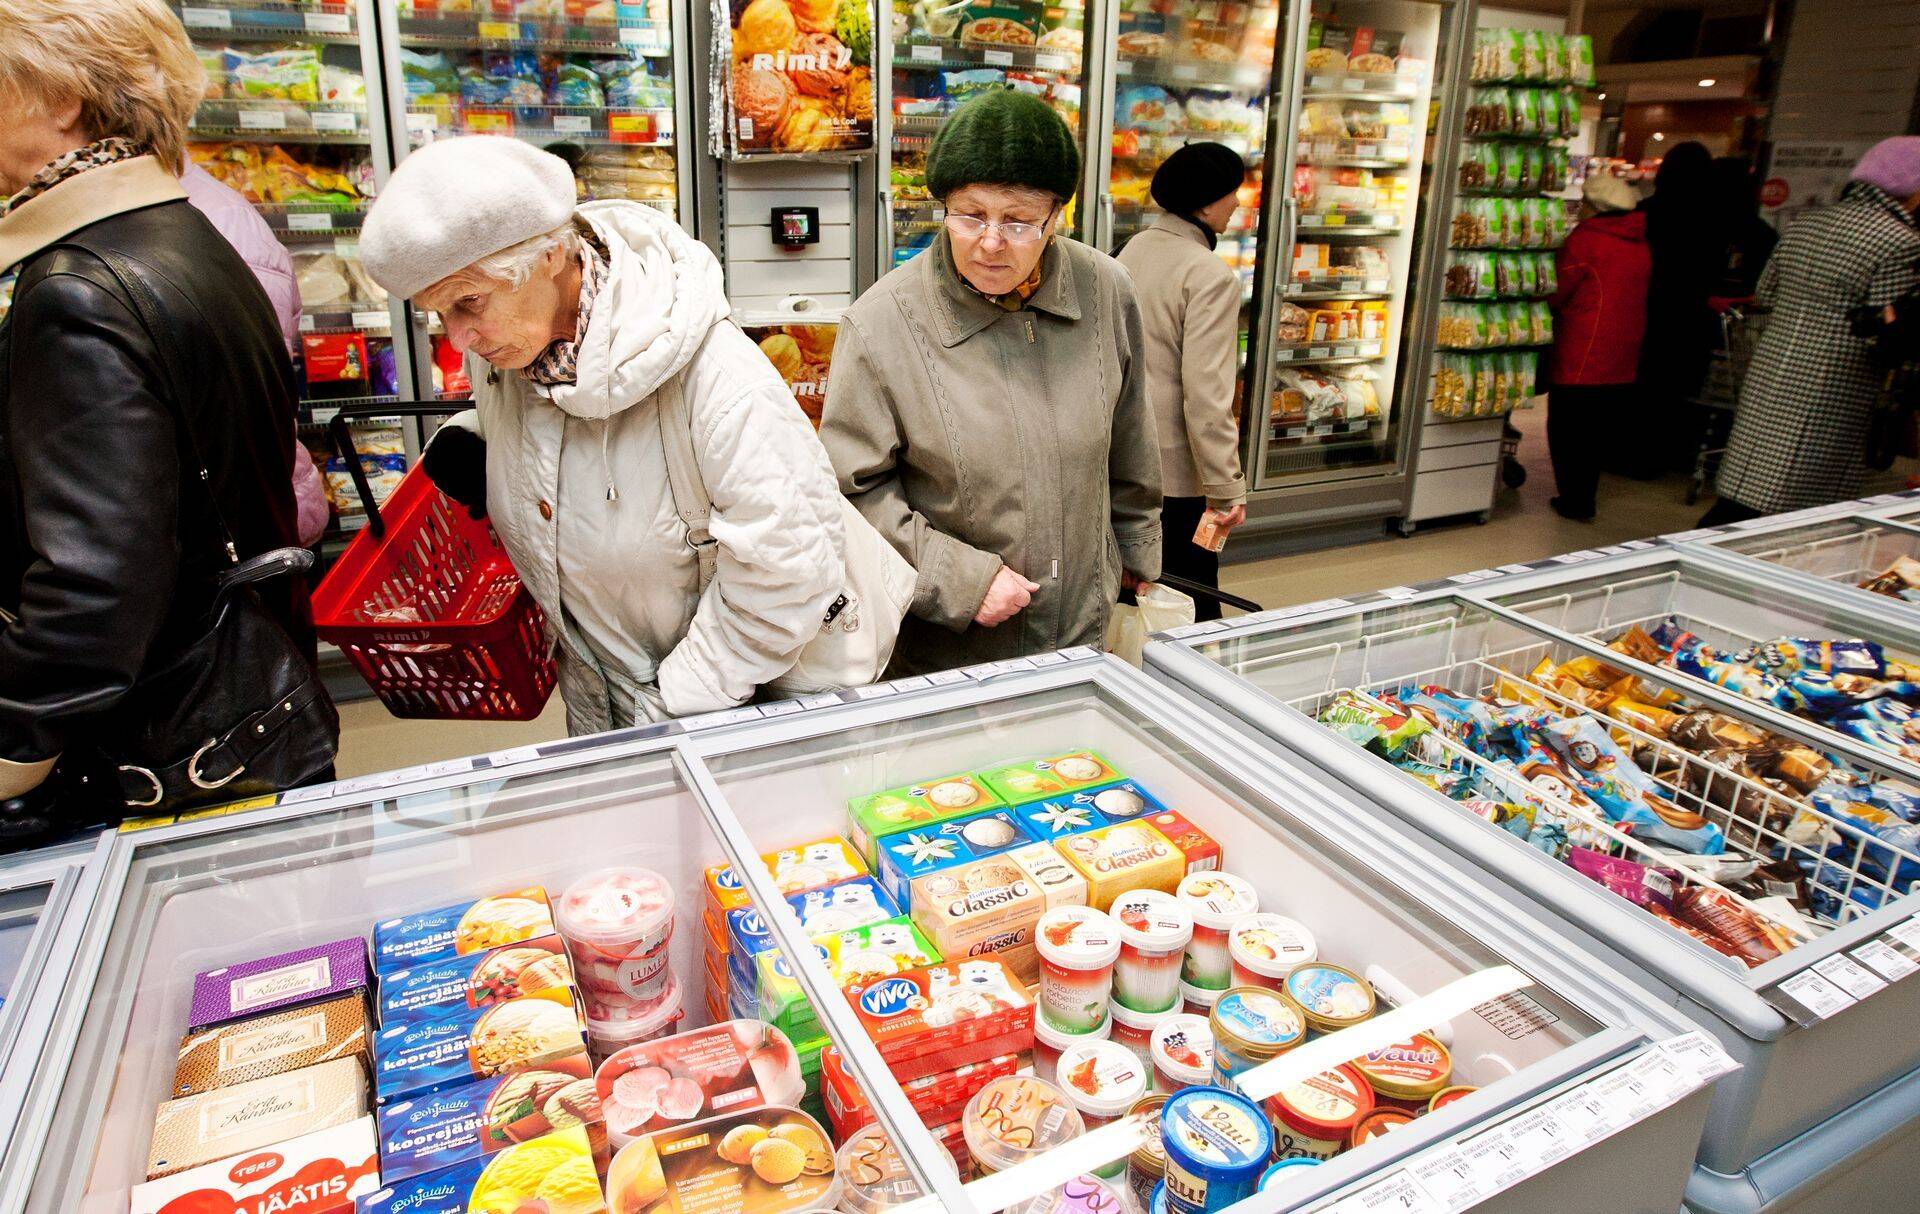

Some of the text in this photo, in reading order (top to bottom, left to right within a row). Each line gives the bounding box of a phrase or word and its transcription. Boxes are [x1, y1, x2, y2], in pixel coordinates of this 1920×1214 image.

[752, 49, 831, 72] Rimi
[841, 116, 857, 125] Cool
[388, 1115, 498, 1153] koorejäätis
